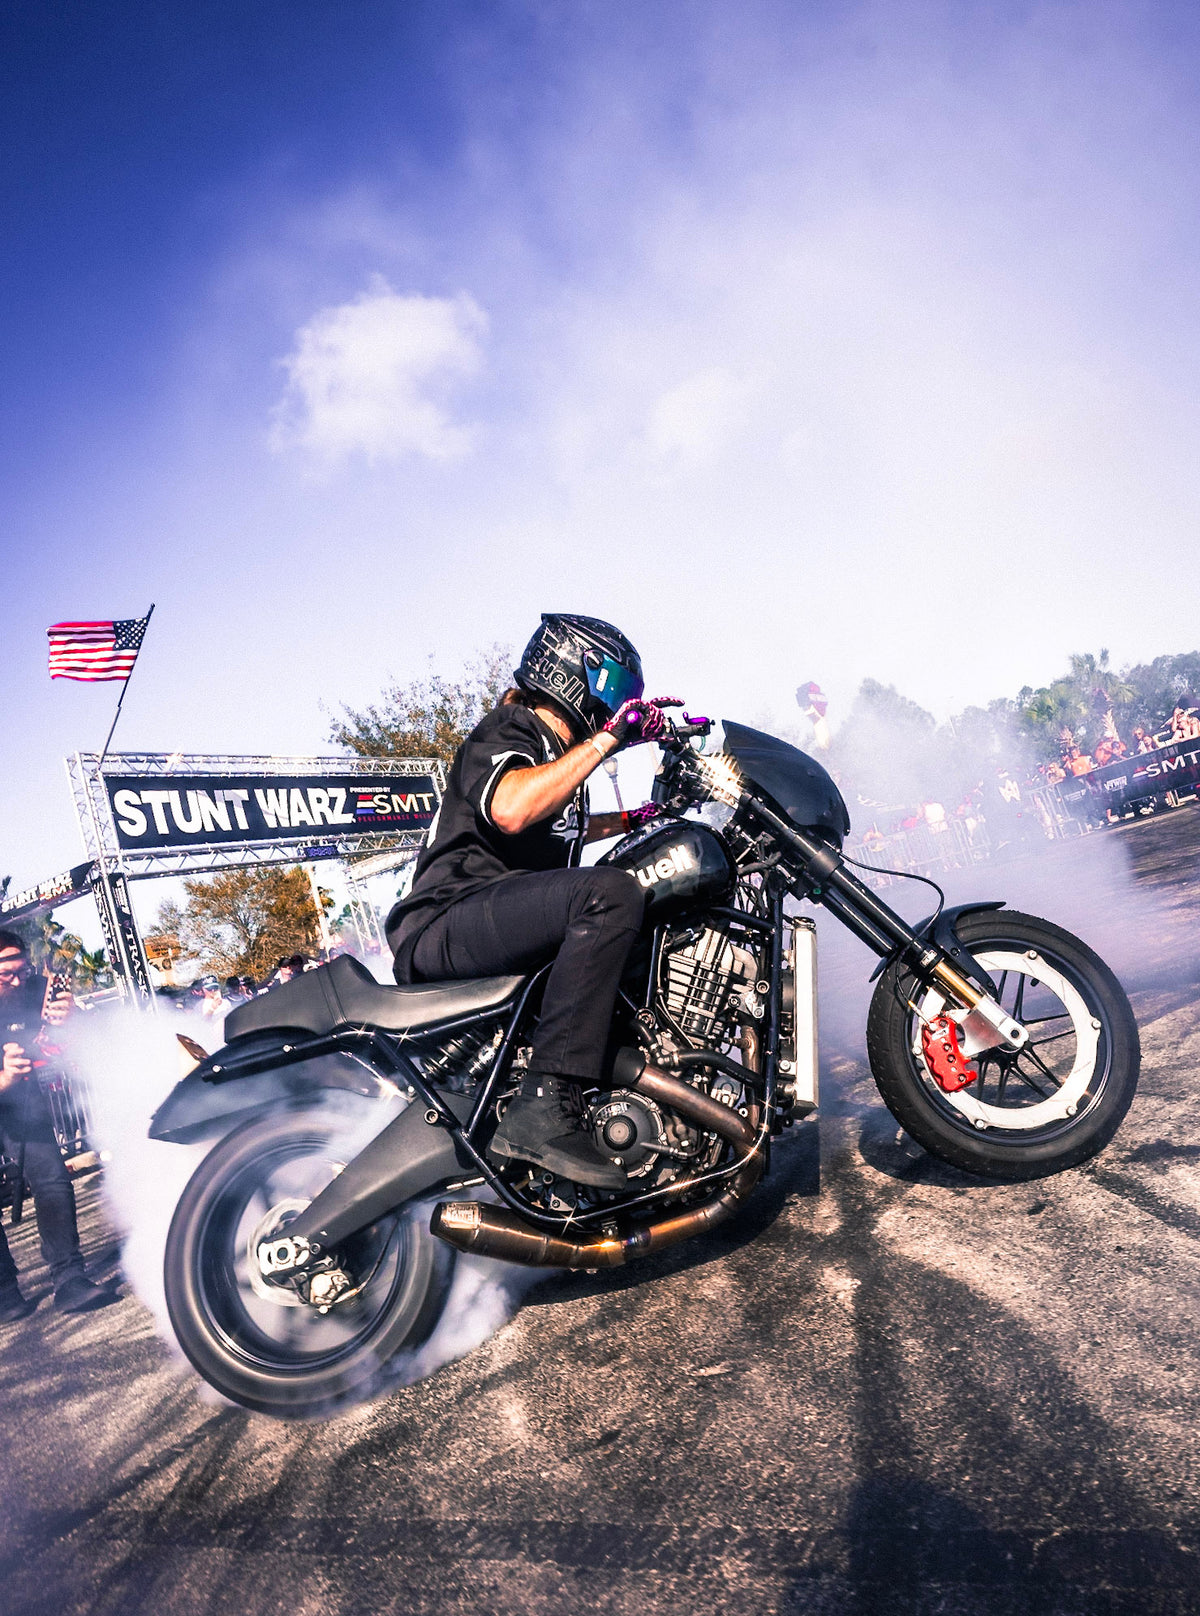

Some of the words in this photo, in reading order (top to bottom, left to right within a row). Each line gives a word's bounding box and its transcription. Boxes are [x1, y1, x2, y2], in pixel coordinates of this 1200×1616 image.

[1146, 749, 1200, 778] SMT
[114, 789, 249, 837] STUNT
[254, 787, 353, 829] WARZ
[372, 792, 434, 815] SMT
[1, 886, 39, 913] STUNT
[39, 870, 73, 894] WARZ
[126, 927, 149, 1001] TRASK
